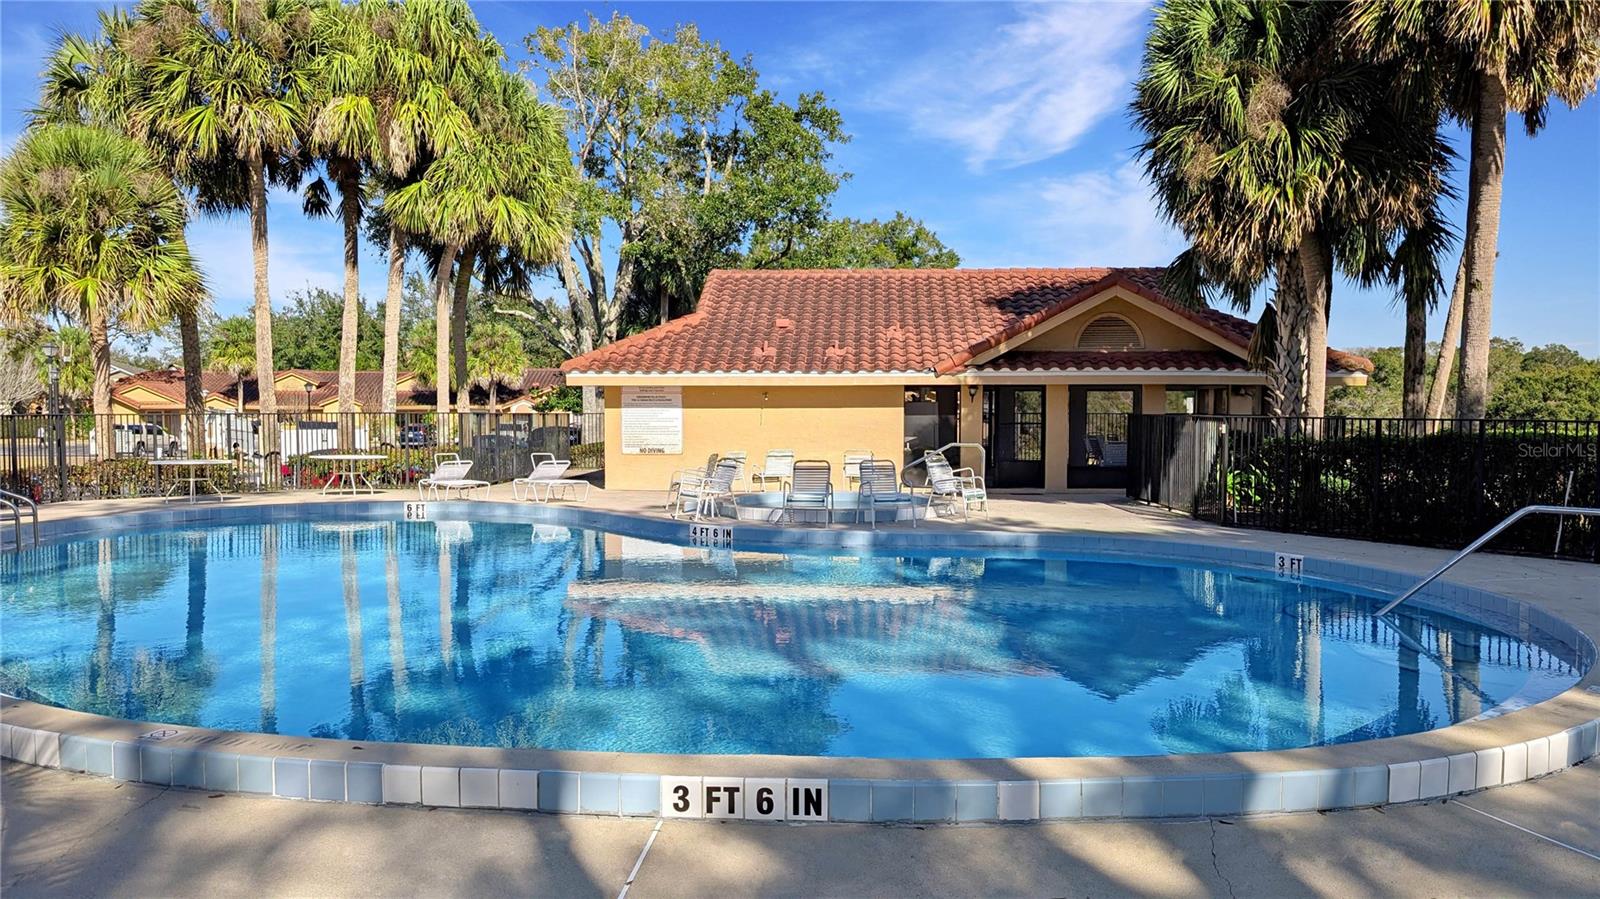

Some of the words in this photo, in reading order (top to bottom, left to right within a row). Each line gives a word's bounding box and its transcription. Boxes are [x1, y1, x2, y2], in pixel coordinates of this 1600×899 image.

[407, 504, 412, 512] 6
[416, 504, 425, 512] FT
[692, 526, 698, 536] 4
[700, 527, 710, 537] FT
[713, 528, 719, 538] 6
[722, 529, 732, 539] IN
[1278, 556, 1285, 568] 3
[1290, 558, 1302, 570] FT
[672, 785, 691, 813] 3
[706, 786, 740, 814] FT
[756, 787, 774, 815] 6
[792, 787, 822, 816] IN
